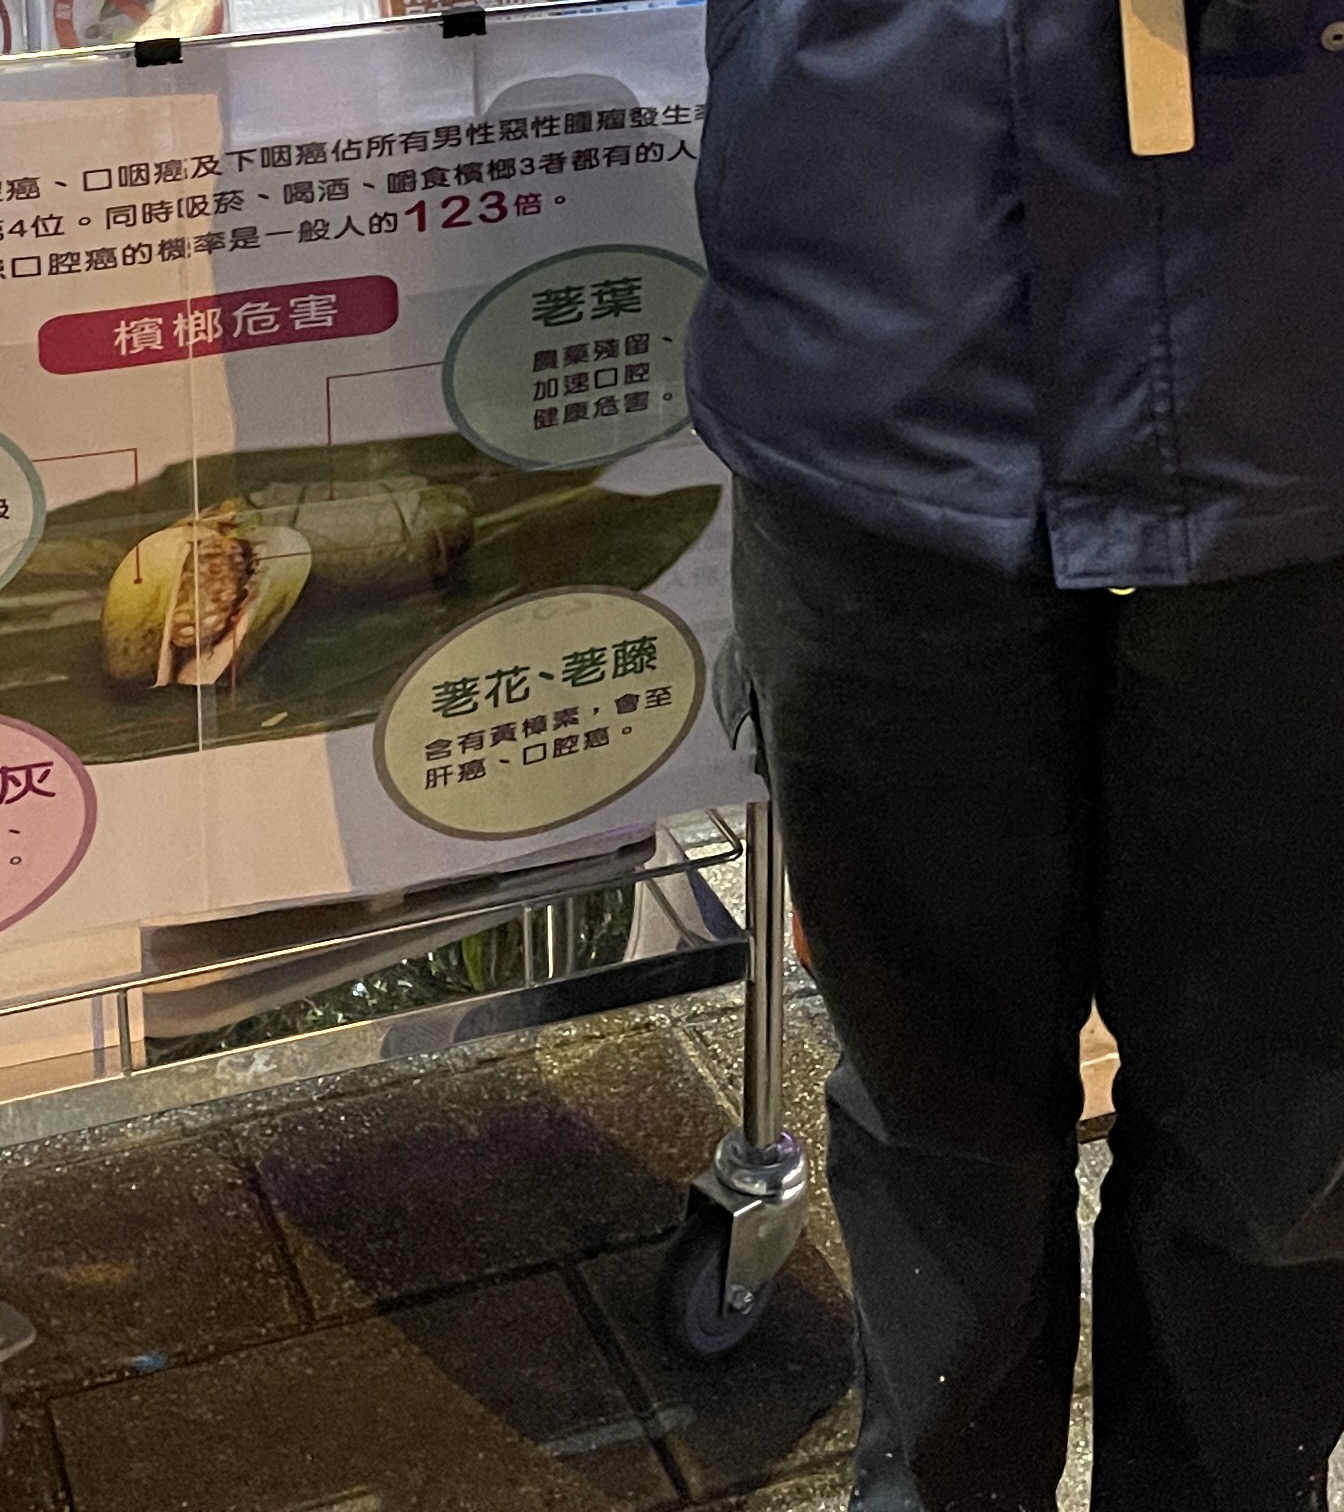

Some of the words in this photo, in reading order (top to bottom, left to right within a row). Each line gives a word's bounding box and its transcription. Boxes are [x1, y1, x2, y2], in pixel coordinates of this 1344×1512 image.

[531, 276, 643, 327] 荖葉
[113, 293, 339, 357] 檳榔危害
[532, 362, 650, 401] 加速口腔
[533, 391, 673, 430] 健康危害。
